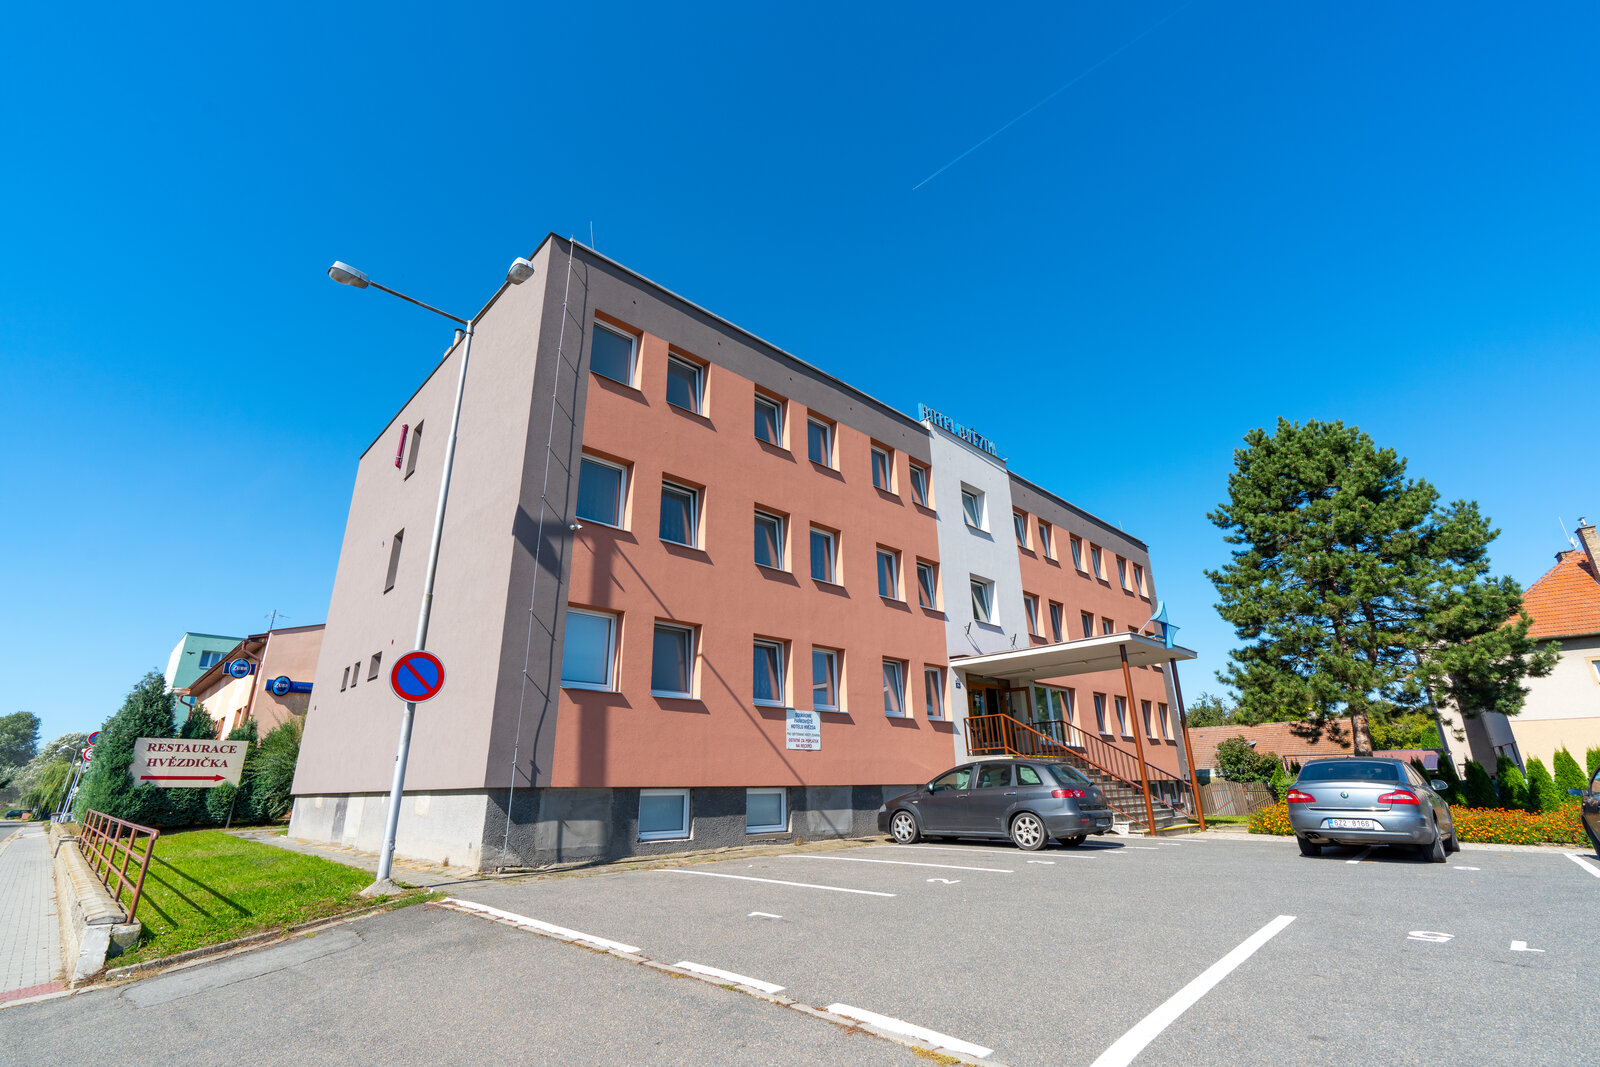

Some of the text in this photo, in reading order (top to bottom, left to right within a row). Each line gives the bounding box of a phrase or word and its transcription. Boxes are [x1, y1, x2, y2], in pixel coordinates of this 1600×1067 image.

[918, 402, 954, 434] HOTEL
[147, 743, 237, 754] RESTAURACE
[147, 756, 228, 768] HVĚZDIČKA
